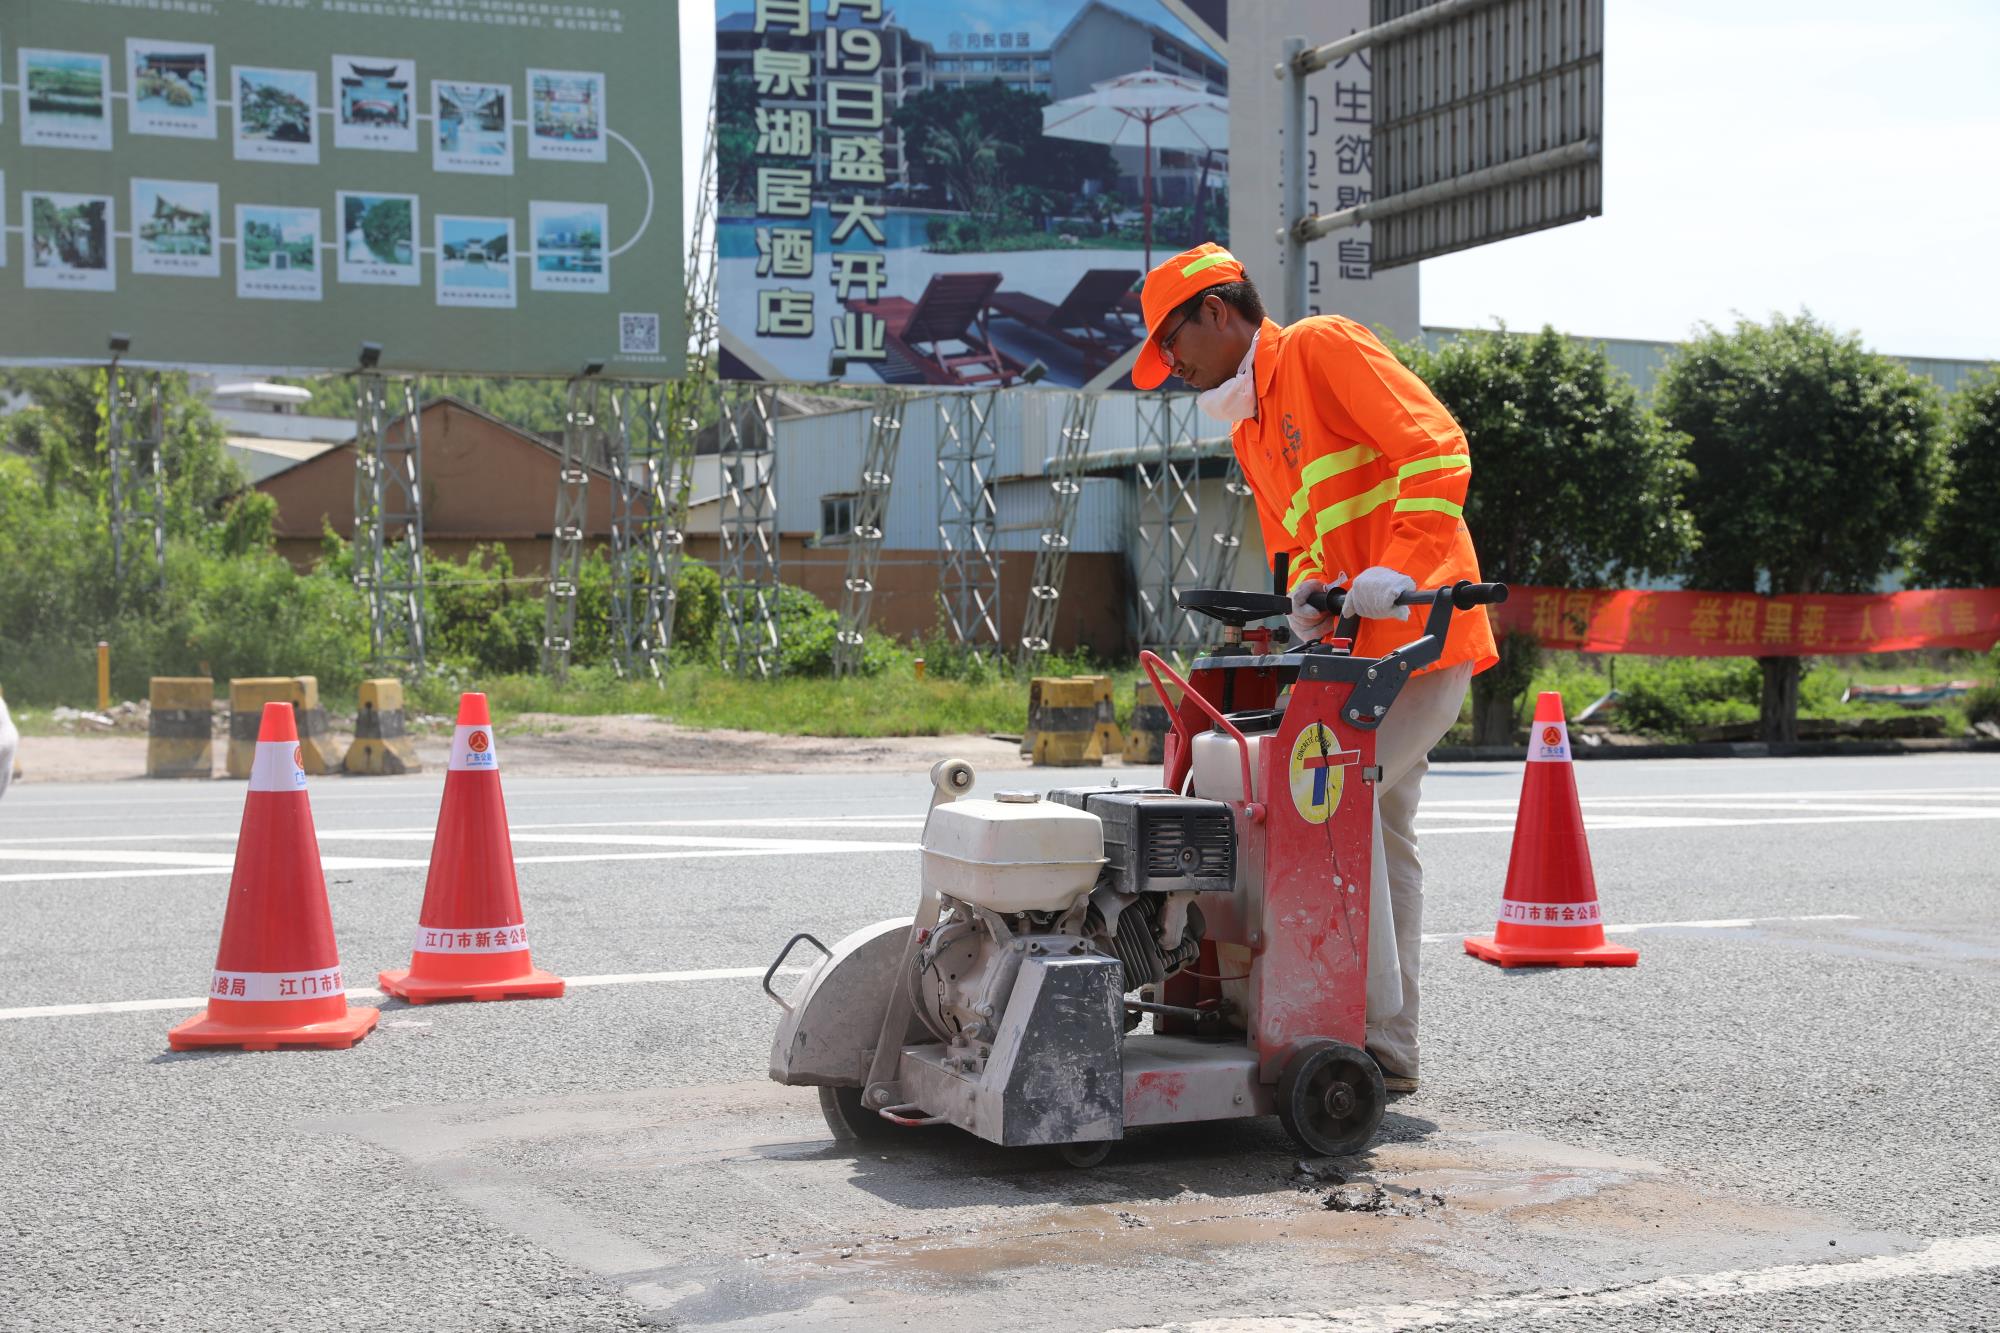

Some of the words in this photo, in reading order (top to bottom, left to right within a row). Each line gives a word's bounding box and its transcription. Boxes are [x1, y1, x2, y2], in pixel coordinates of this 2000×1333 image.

[1504, 903, 1600, 921] 江门市新会公路
